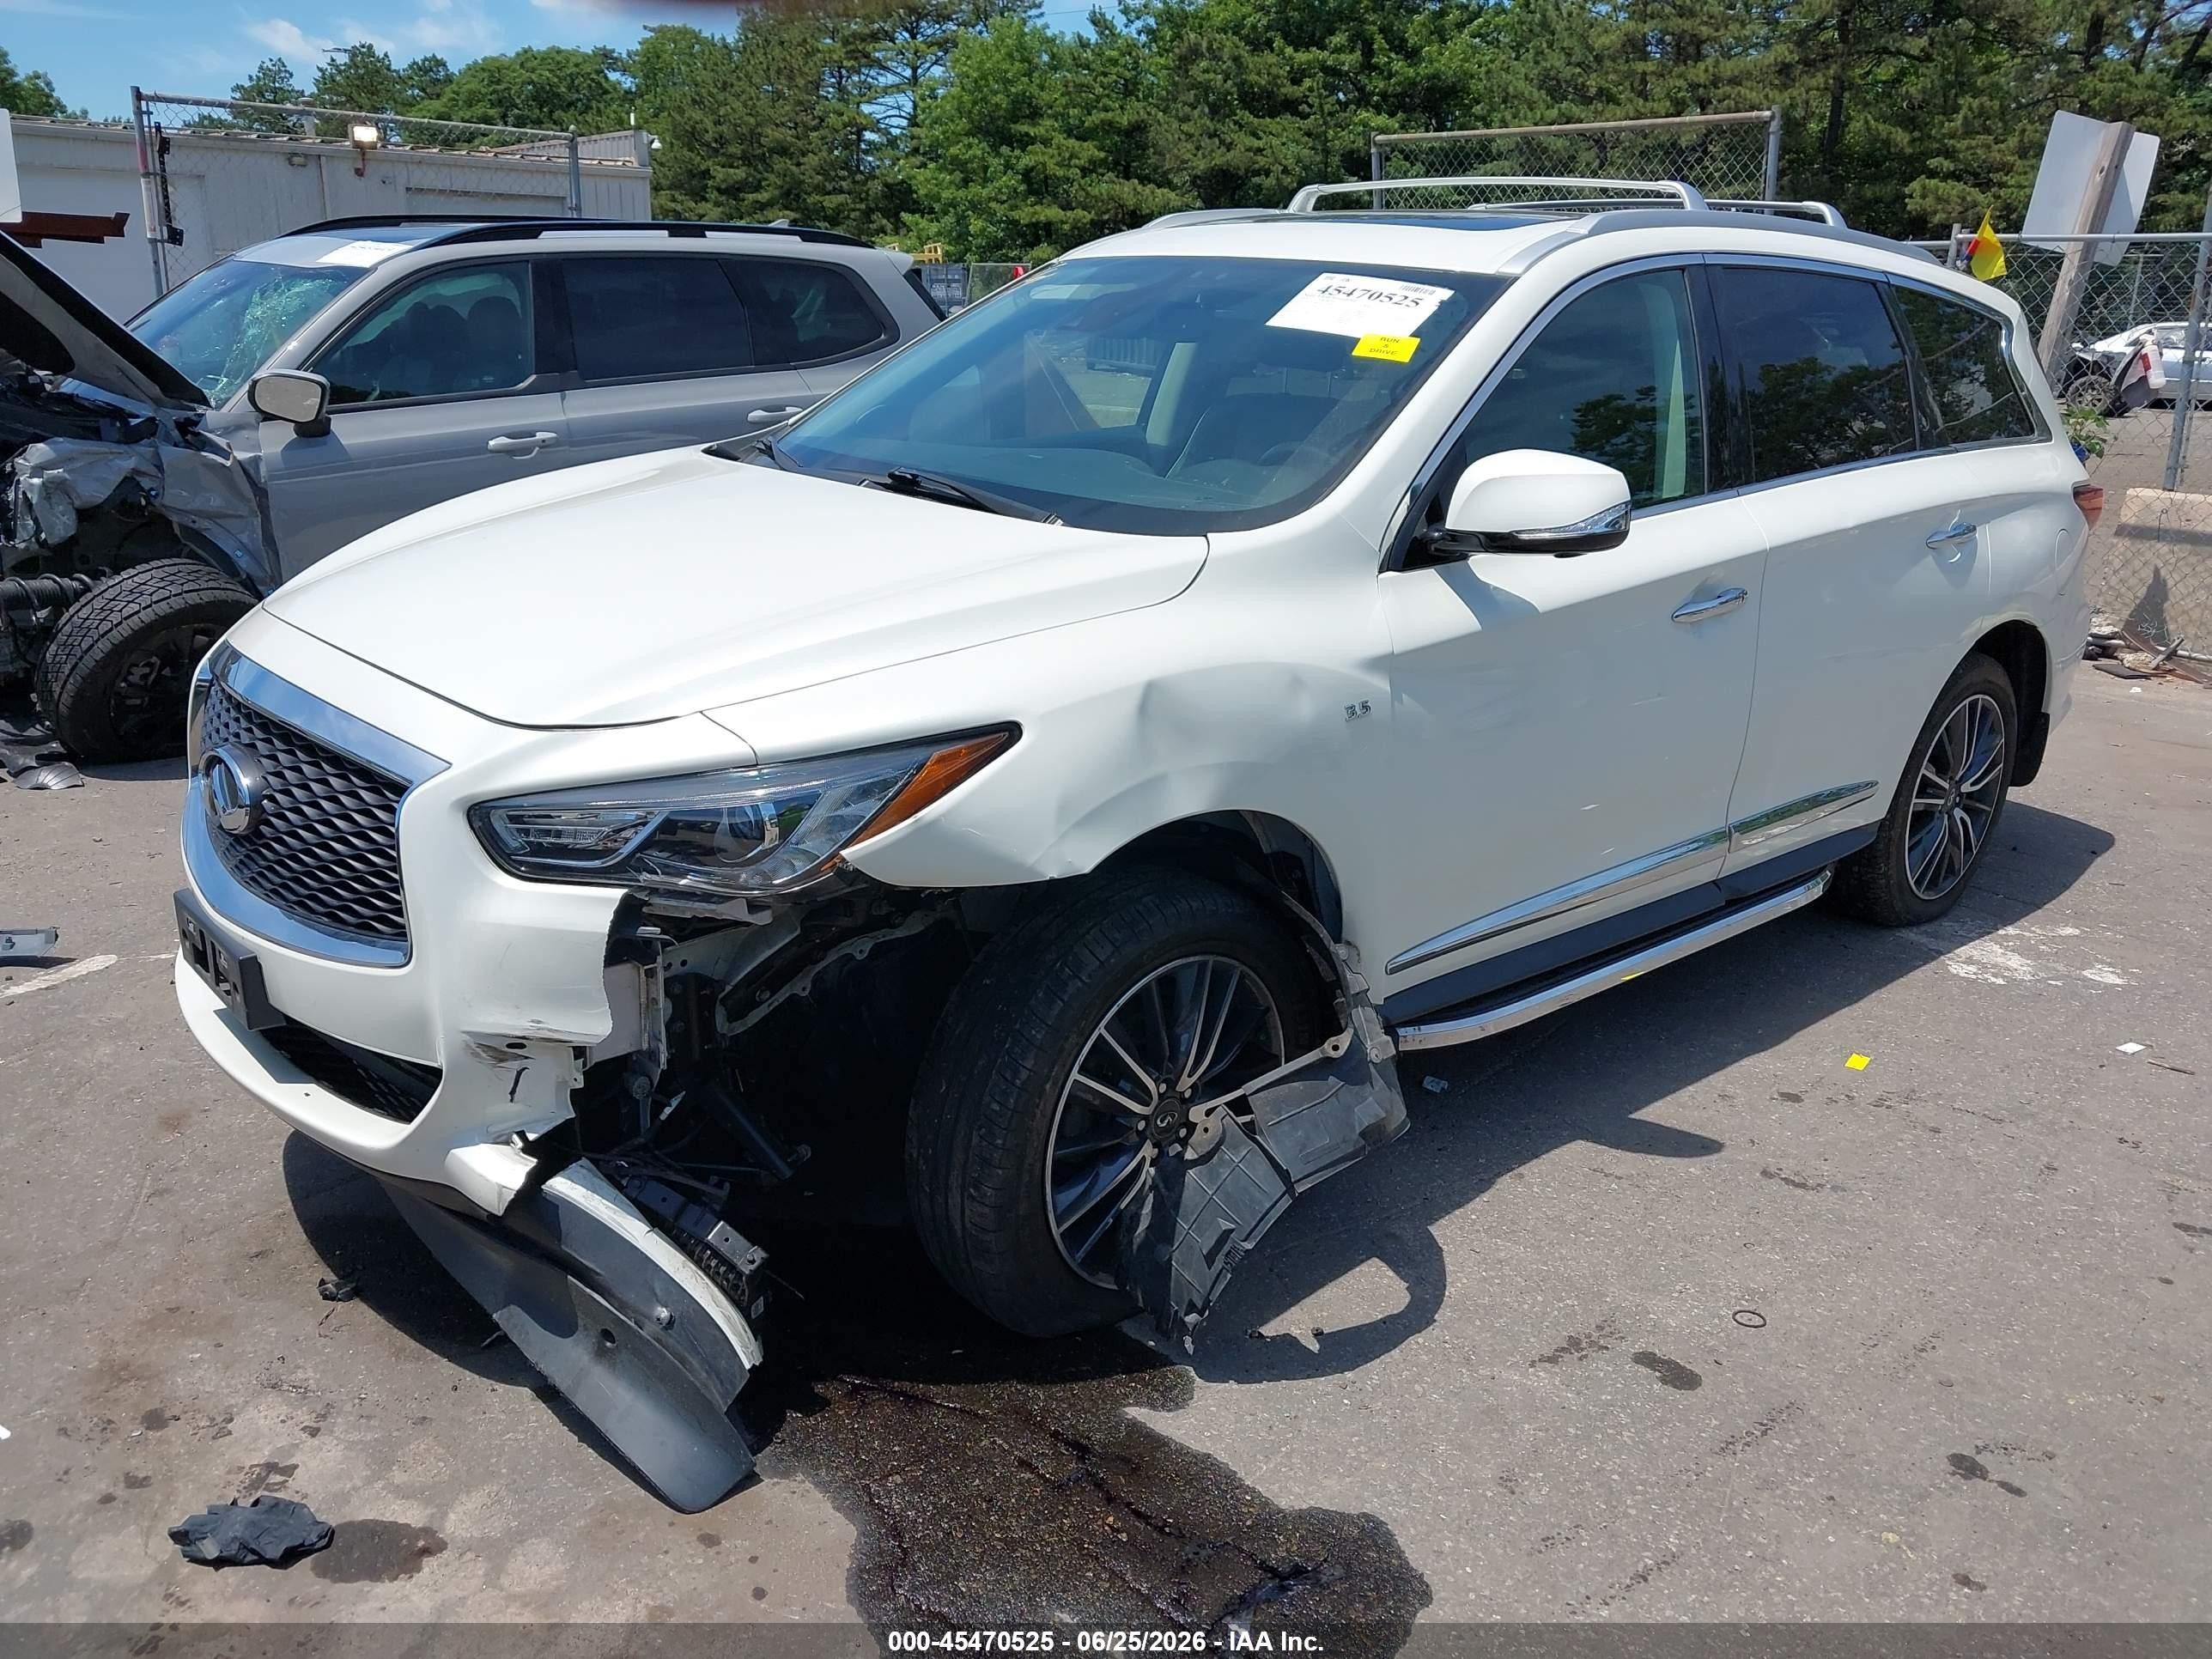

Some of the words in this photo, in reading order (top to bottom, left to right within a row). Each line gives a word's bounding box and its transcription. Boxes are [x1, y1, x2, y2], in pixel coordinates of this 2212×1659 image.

[1316, 283, 1425, 308] 45470525
[1379, 336, 1401, 344] RUN
[1369, 347, 1398, 356] DRIVE
[1345, 699, 1371, 722] 3.5
